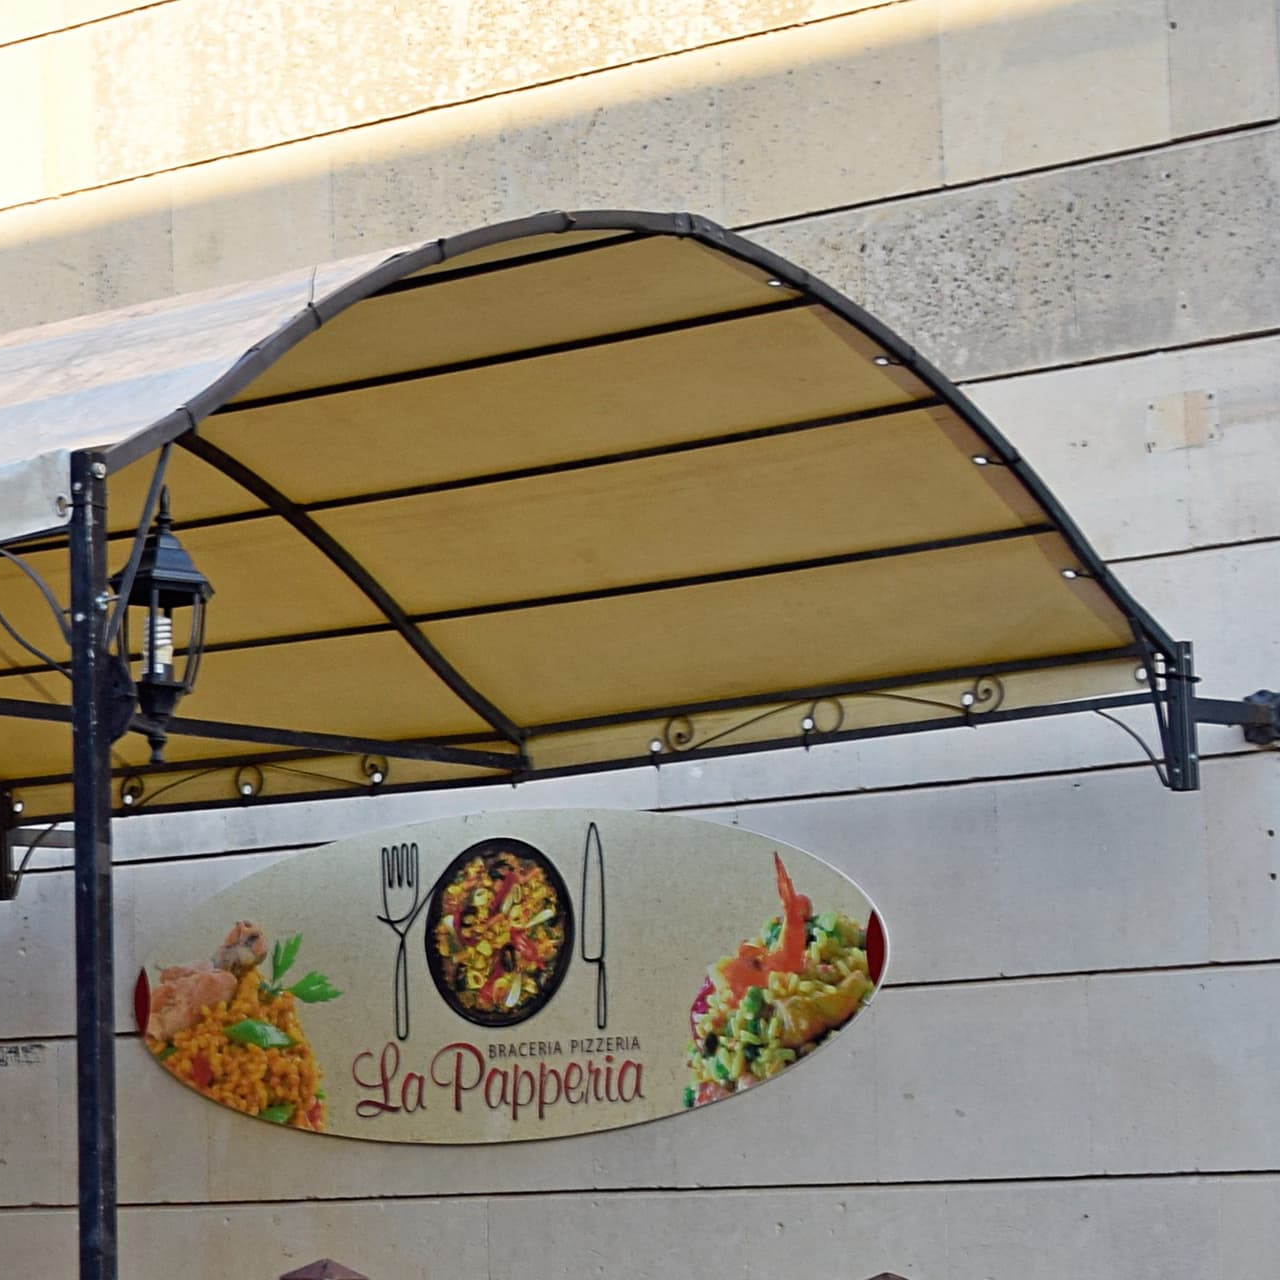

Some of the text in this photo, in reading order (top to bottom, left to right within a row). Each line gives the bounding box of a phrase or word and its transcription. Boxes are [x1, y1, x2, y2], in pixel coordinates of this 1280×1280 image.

[489, 1036, 641, 1059] BRACERIA PIZZERIA
[352, 1042, 646, 1121] La Papperia
